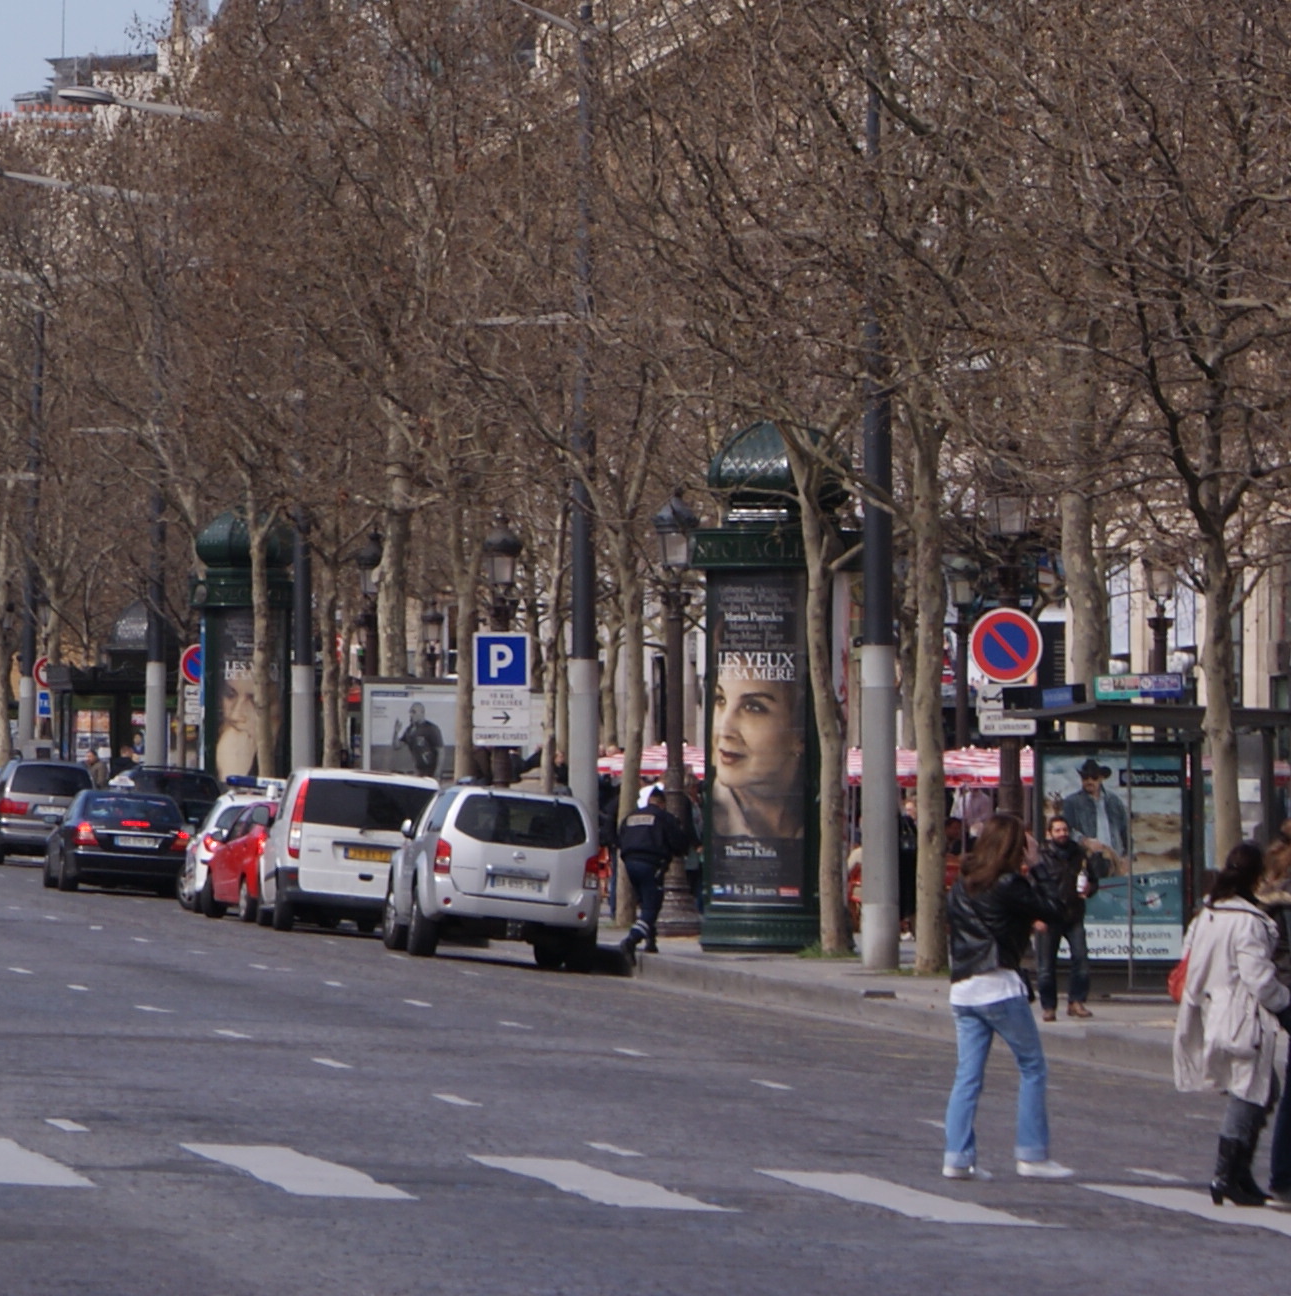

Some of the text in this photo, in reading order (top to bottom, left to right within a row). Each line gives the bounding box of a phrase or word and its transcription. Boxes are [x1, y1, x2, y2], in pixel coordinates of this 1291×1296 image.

[489, 644, 514, 678] P
[718, 651, 795, 668] LES YEUX
[1154, 770, 1179, 783] 2000
